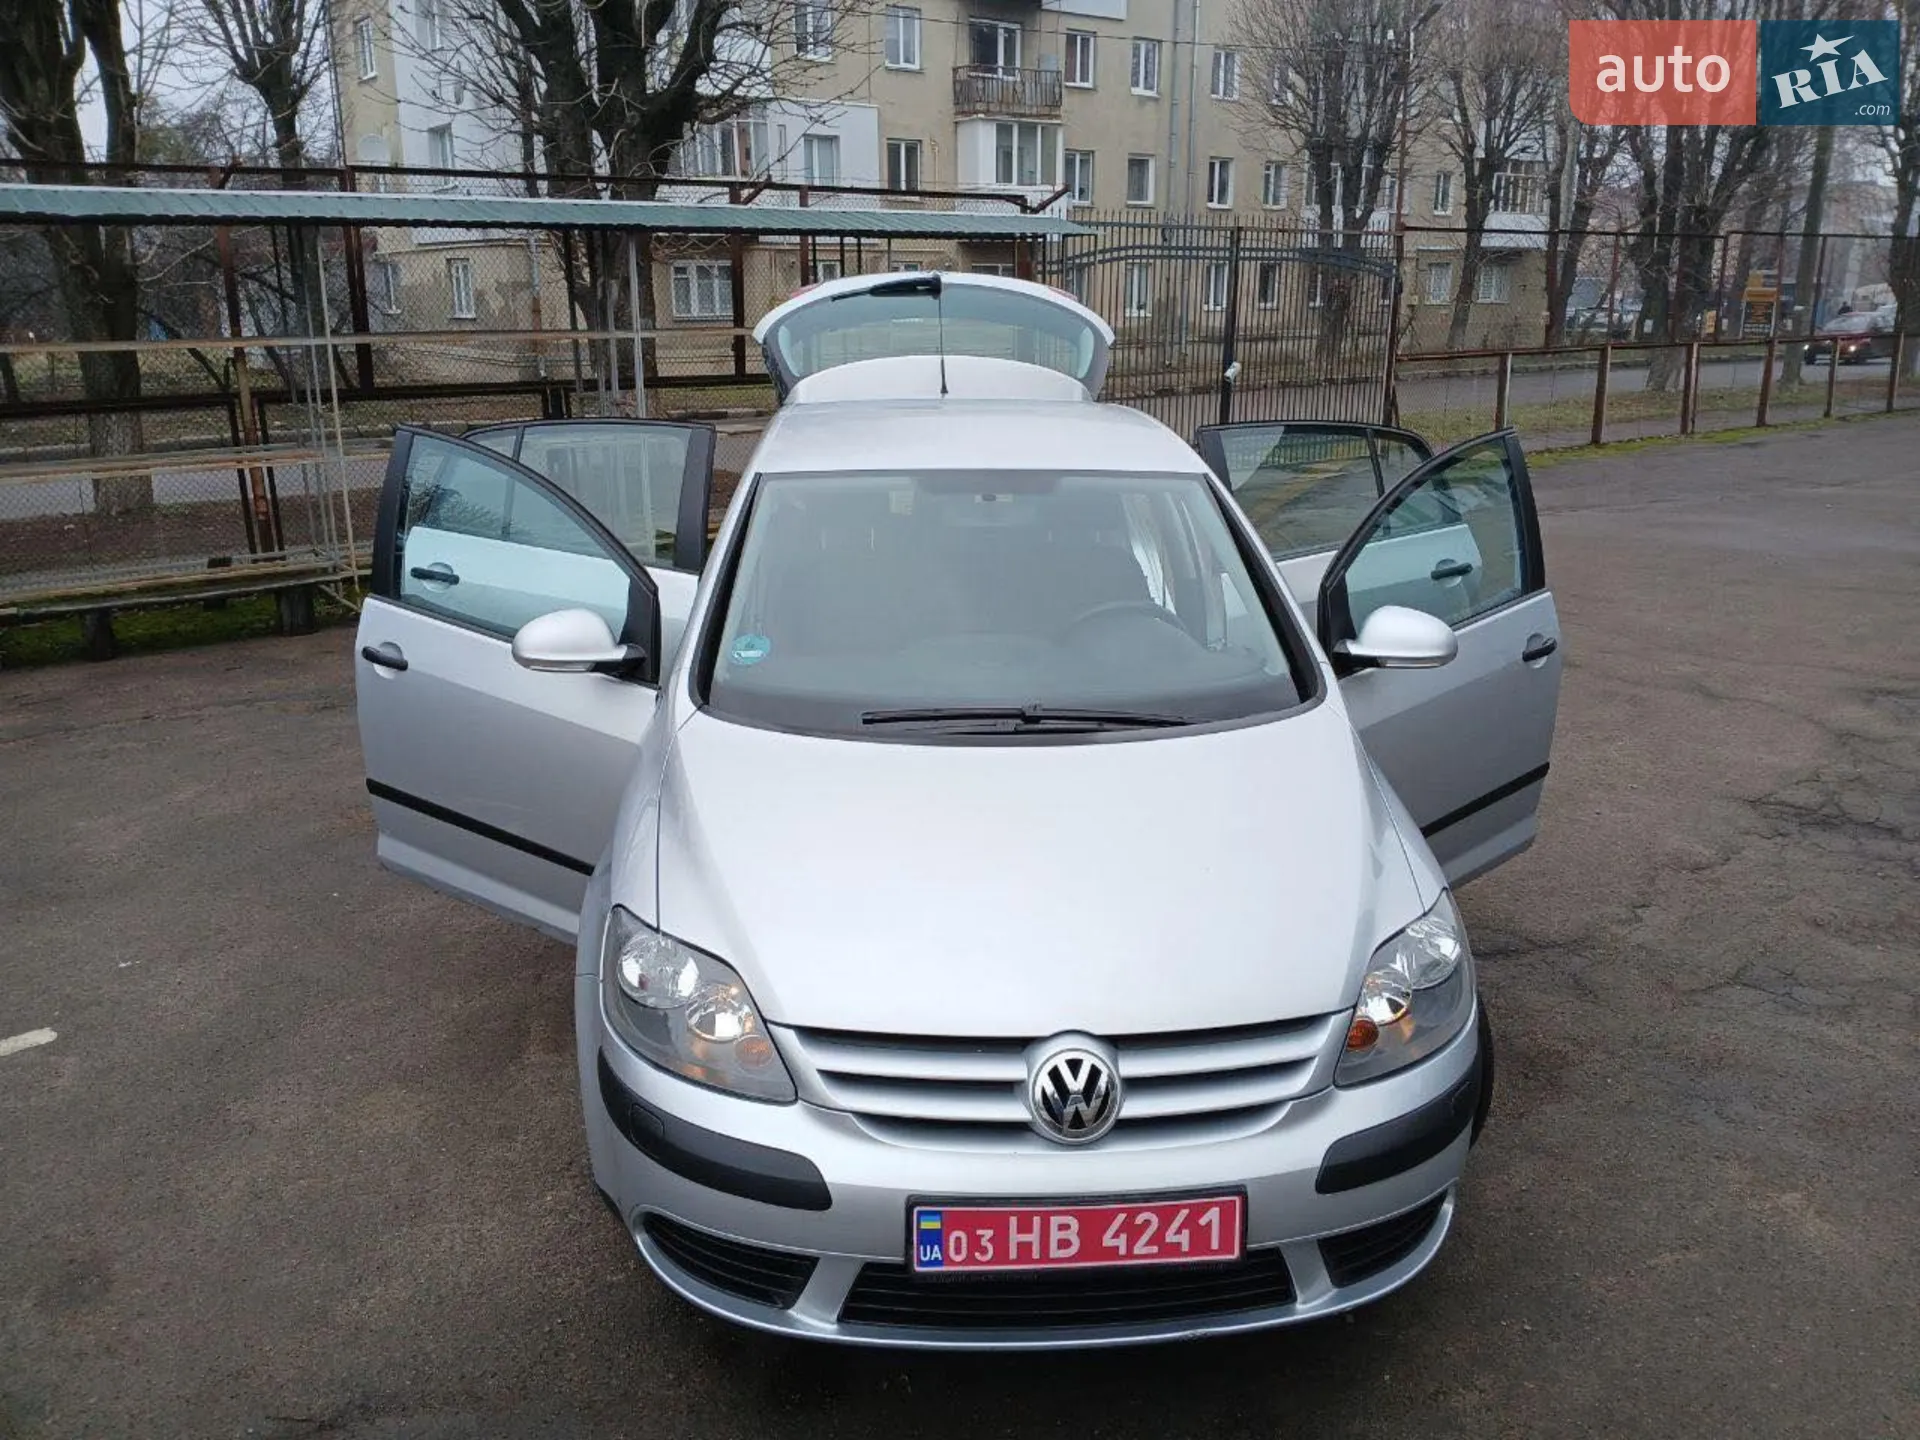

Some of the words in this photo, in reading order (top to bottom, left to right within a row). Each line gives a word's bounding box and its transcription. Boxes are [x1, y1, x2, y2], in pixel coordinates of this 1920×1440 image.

[1034, 1053, 1116, 1135] VW
[920, 1245, 942, 1261] UA
[948, 1229, 994, 1262] 03
[1008, 1216, 1081, 1260] HB
[1101, 1207, 1221, 1256] 4241
